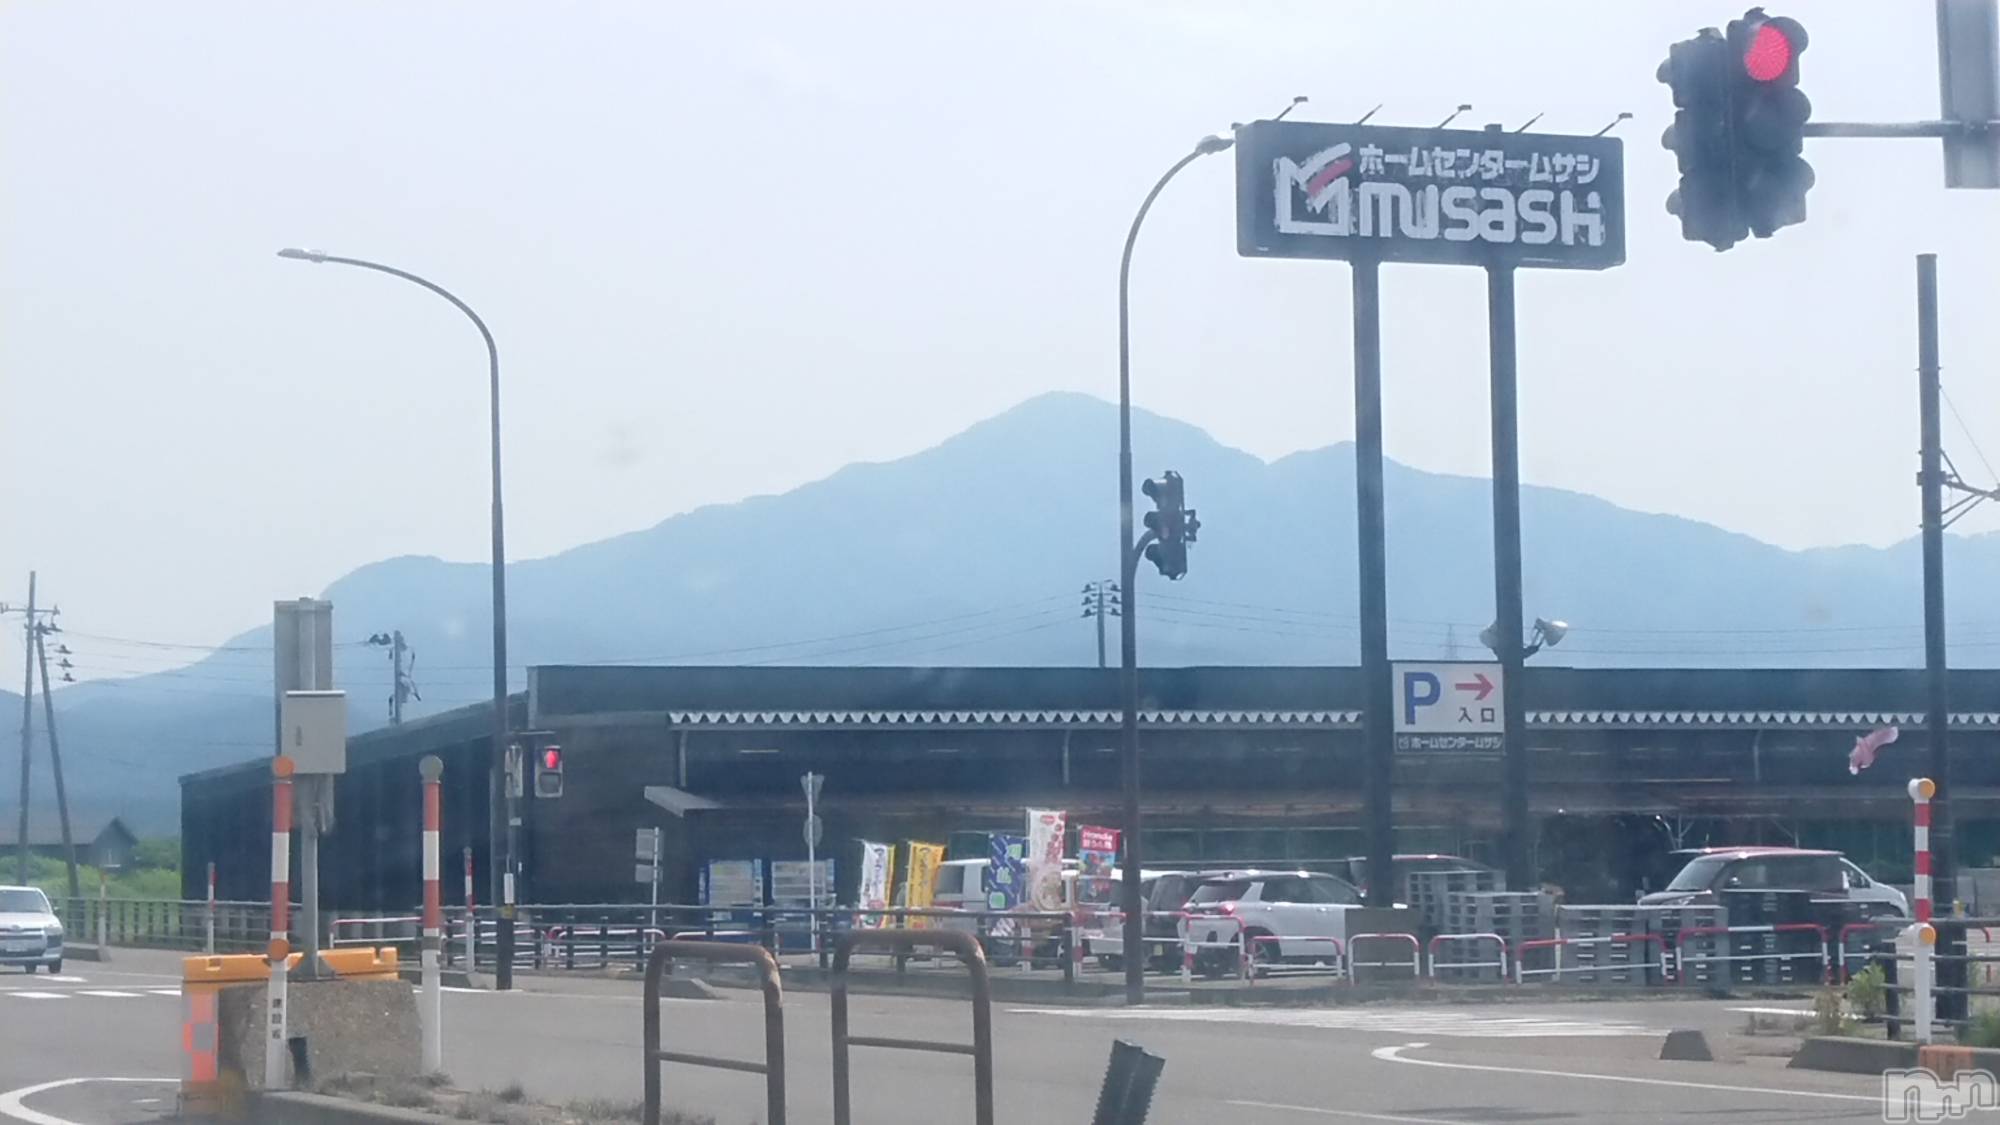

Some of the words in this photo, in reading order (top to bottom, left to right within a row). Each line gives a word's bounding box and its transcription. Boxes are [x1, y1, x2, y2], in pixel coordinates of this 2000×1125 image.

[1358, 143, 1600, 184] ホームセンタームサシ
[1403, 671, 1441, 725] P
[1457, 706, 1495, 723] 入口
[1410, 736, 1502, 749] ホームセンタームサシ
